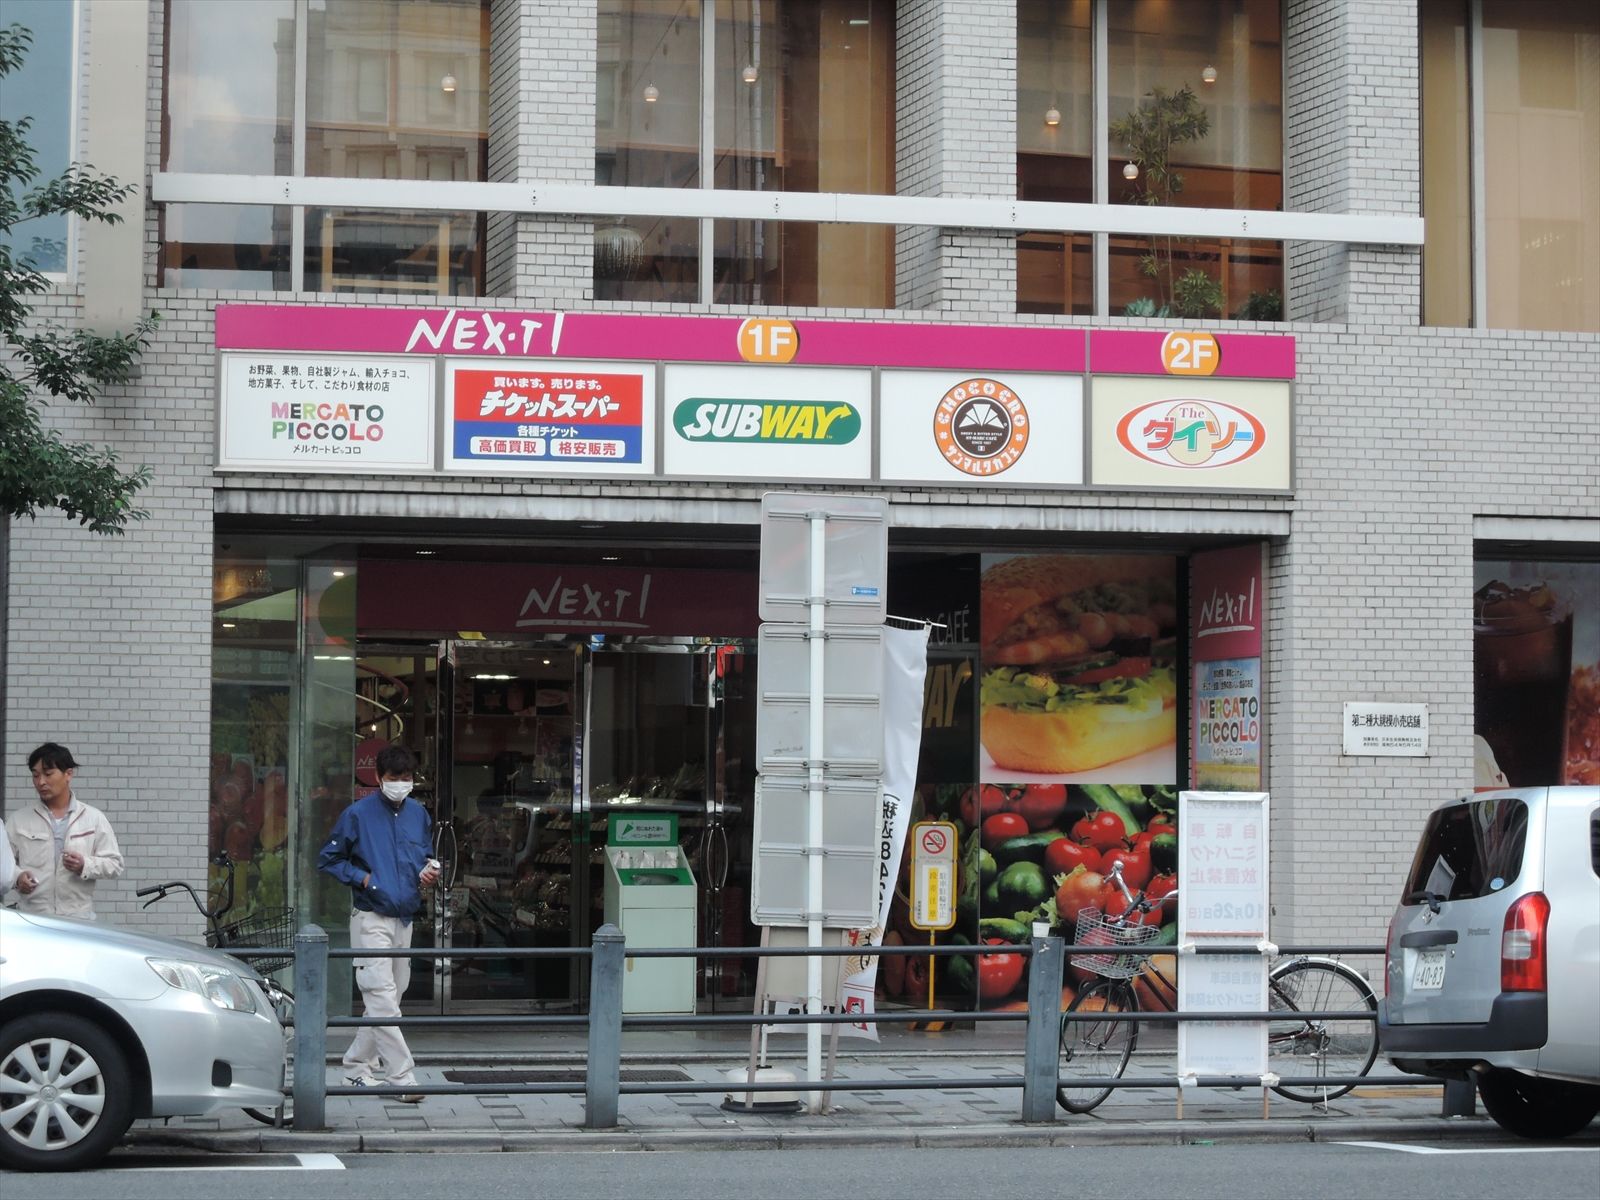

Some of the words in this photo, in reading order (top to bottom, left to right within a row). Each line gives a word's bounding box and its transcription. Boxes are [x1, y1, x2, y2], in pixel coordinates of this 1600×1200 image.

[747, 325, 793, 357] 1F
[1169, 338, 1214, 369] 2F
[271, 401, 384, 421] MERCATO
[480, 390, 620, 418] チケットスーパー
[1179, 407, 1206, 419] The
[272, 420, 384, 441] PICCOLO
[517, 425, 579, 438] 各種チケット
[683, 402, 852, 441] SUBWAY
[1142, 419, 1254, 451] ダイソー
[292, 443, 362, 455] メルカートピッコロ
[478, 439, 537, 455] 高価買取
[558, 441, 617, 456] 格安販売
[946, 445, 1020, 473] サンマルクカフェ
[938, 604, 970, 646] CAFÉ
[1200, 696, 1258, 719] MERCATO
[1200, 720, 1258, 744] PICCOLO
